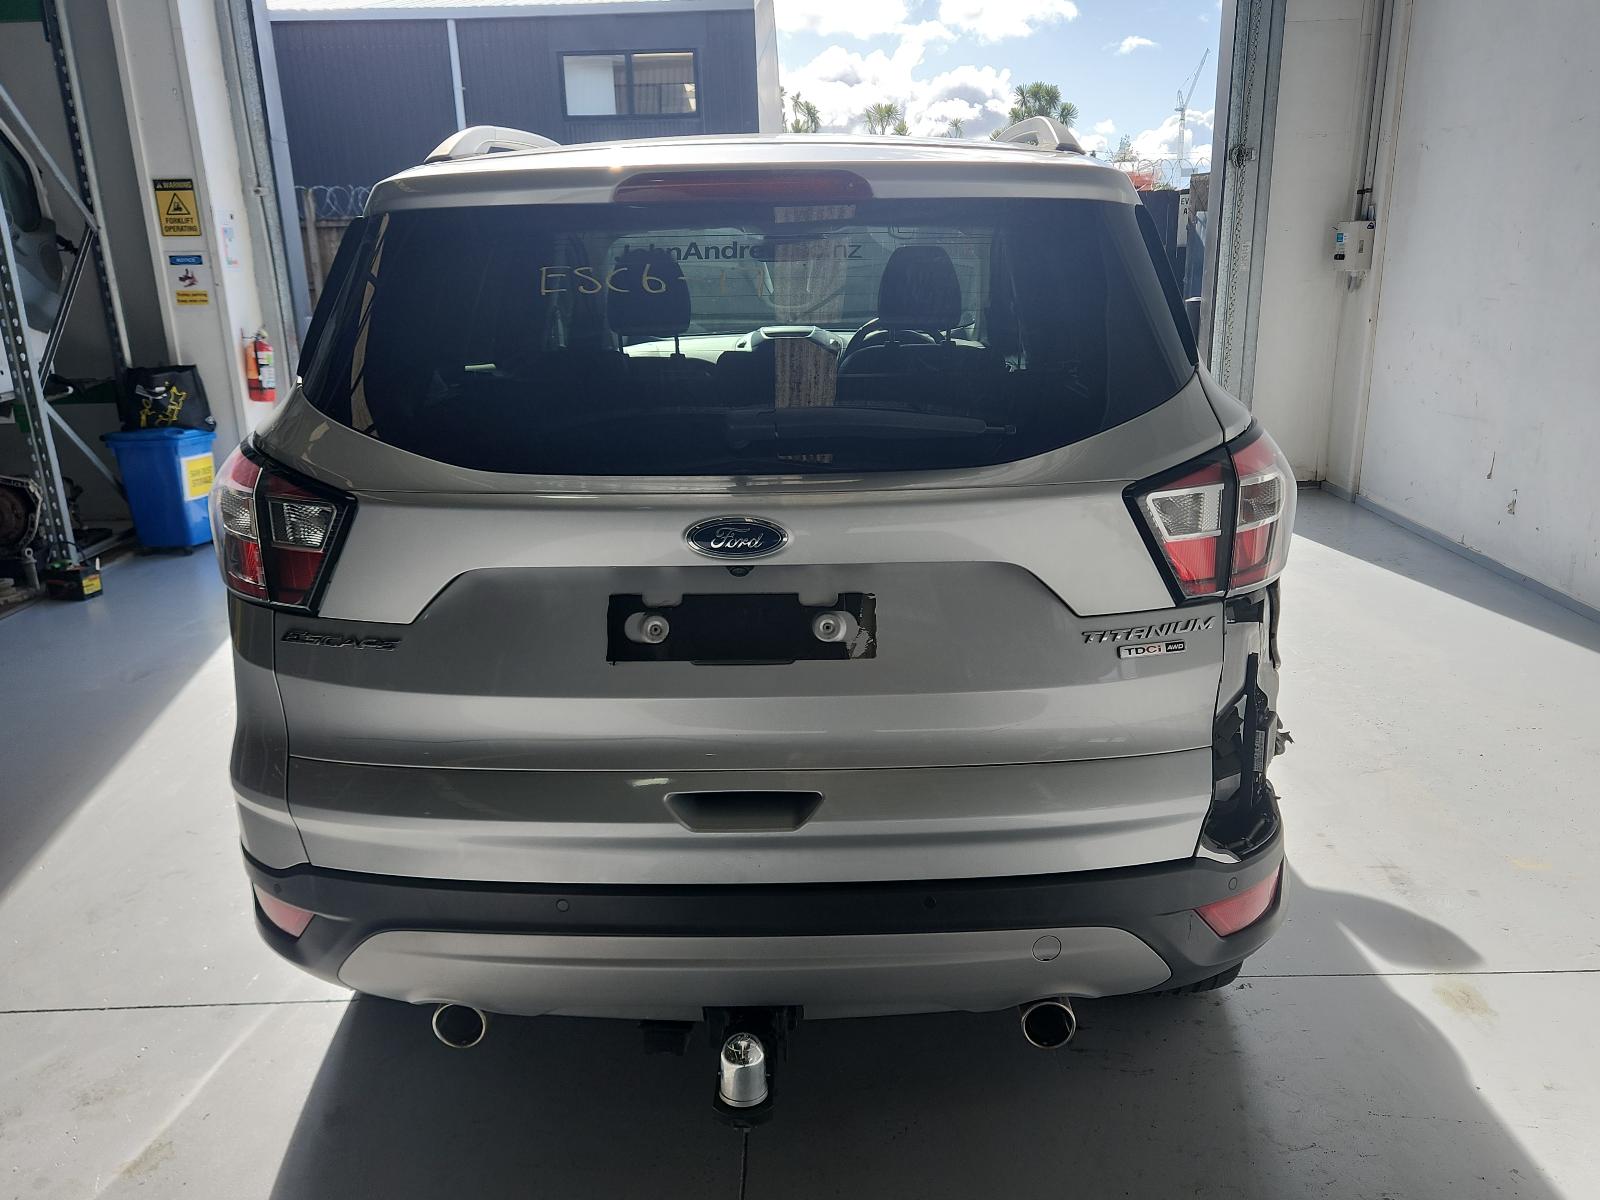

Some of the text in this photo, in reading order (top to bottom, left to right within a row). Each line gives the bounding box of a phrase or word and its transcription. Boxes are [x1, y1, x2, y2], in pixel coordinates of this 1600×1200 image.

[710, 527, 765, 549] Ford
[1081, 615, 1216, 643] TITANIUM
[1124, 642, 1184, 656] TDCi AWD
